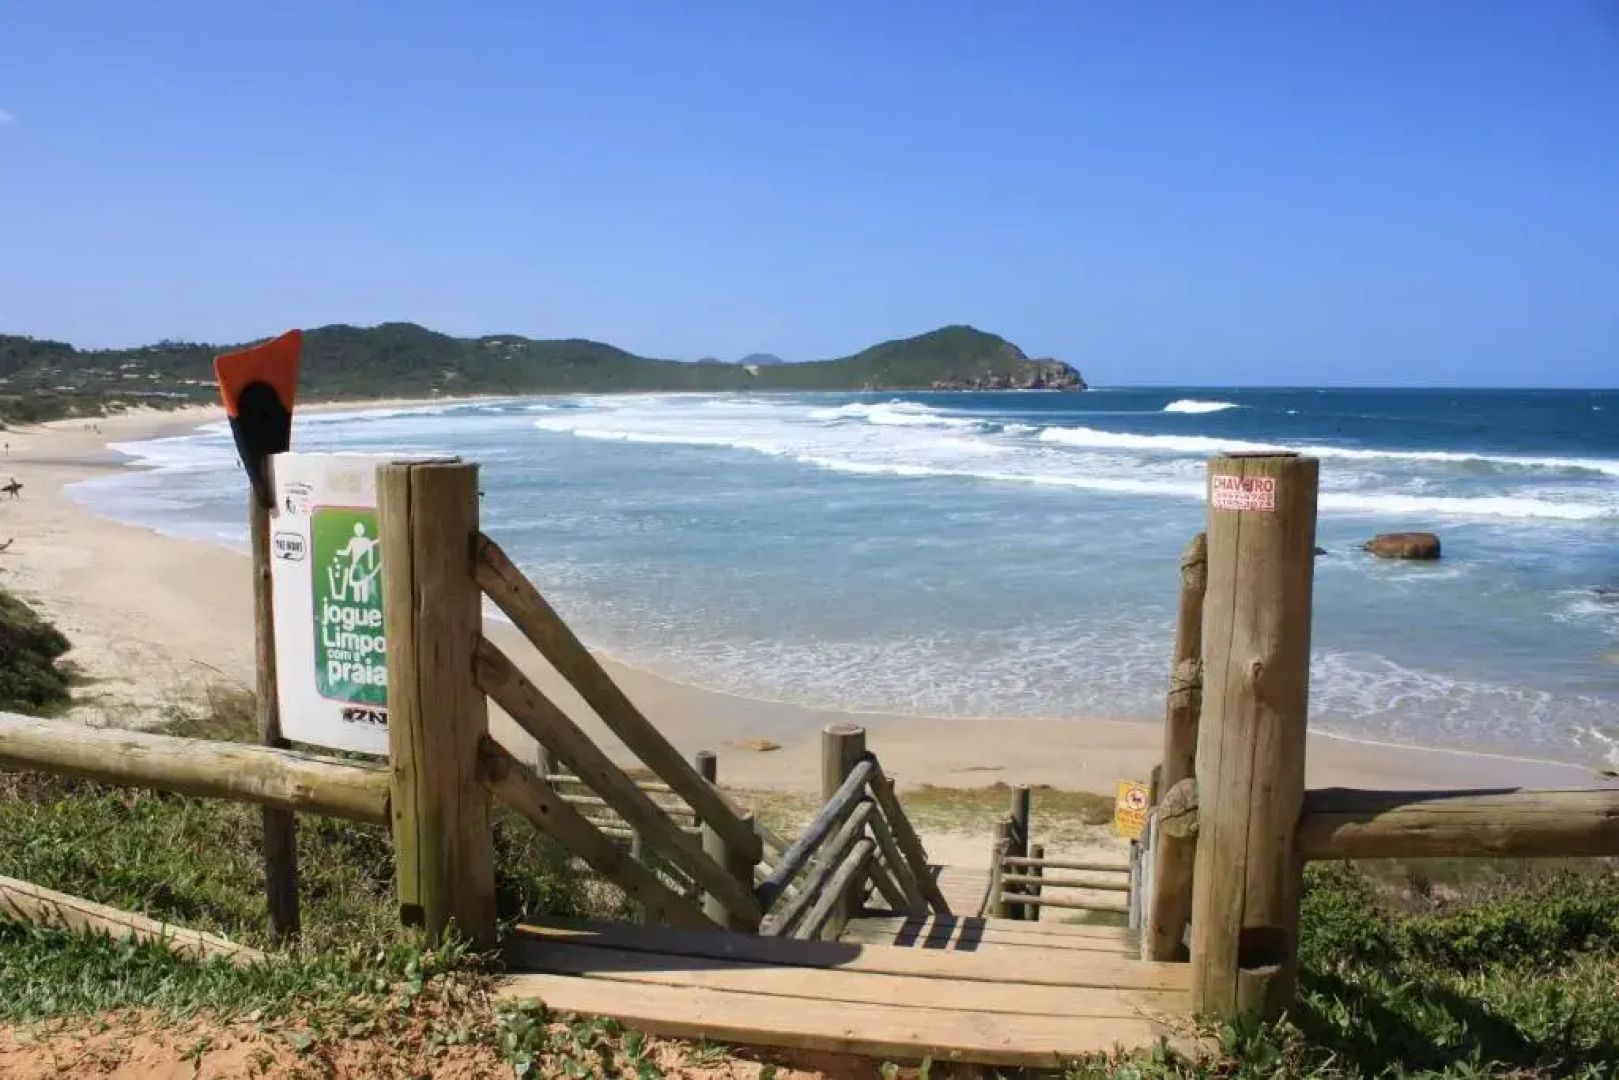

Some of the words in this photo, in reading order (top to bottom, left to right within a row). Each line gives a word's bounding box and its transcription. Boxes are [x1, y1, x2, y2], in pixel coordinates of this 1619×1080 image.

[322, 596, 382, 630] jogue
[322, 626, 387, 656] Limpo
[328, 657, 388, 687] praia
